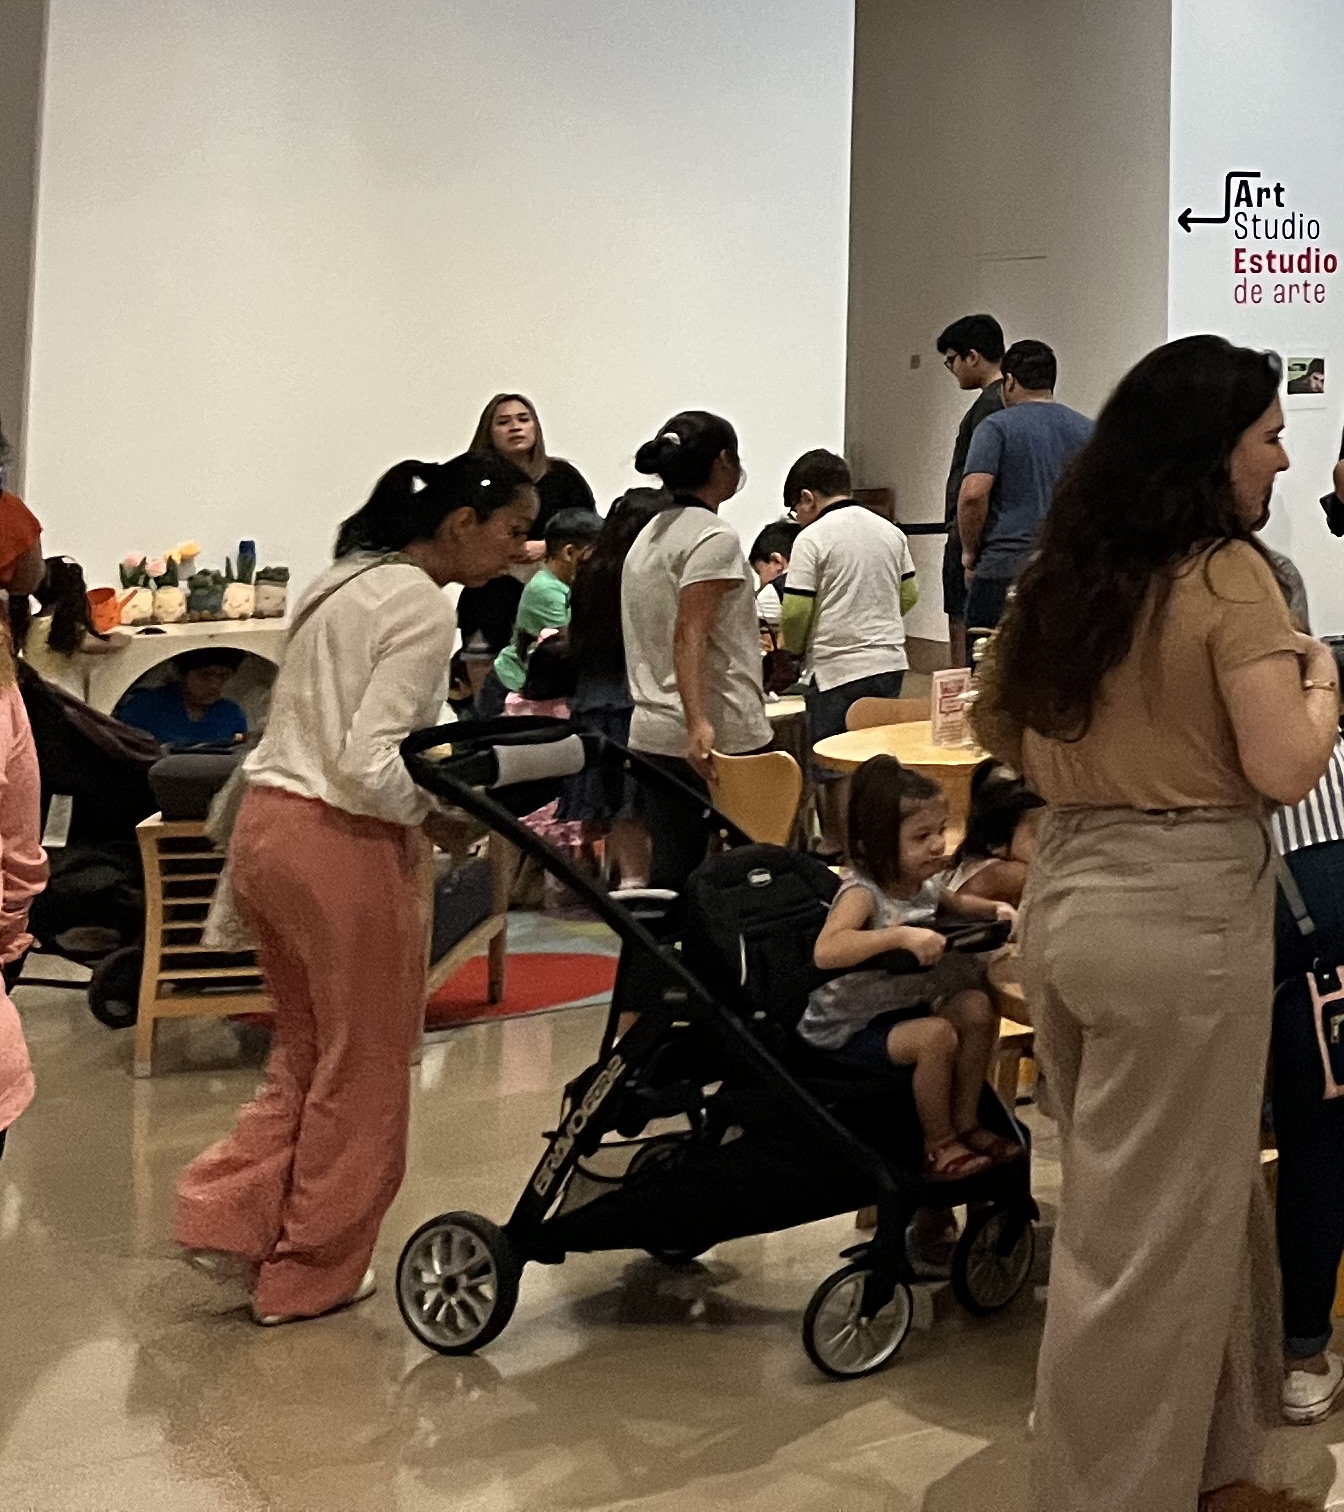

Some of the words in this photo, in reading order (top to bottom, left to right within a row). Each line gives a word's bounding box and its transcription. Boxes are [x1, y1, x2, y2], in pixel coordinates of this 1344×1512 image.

[1234, 180, 1285, 208] Art
[1234, 211, 1320, 240] Studio
[1234, 247, 1338, 274] Estudio
[1234, 277, 1263, 304] de
[1273, 279, 1326, 304] arte
